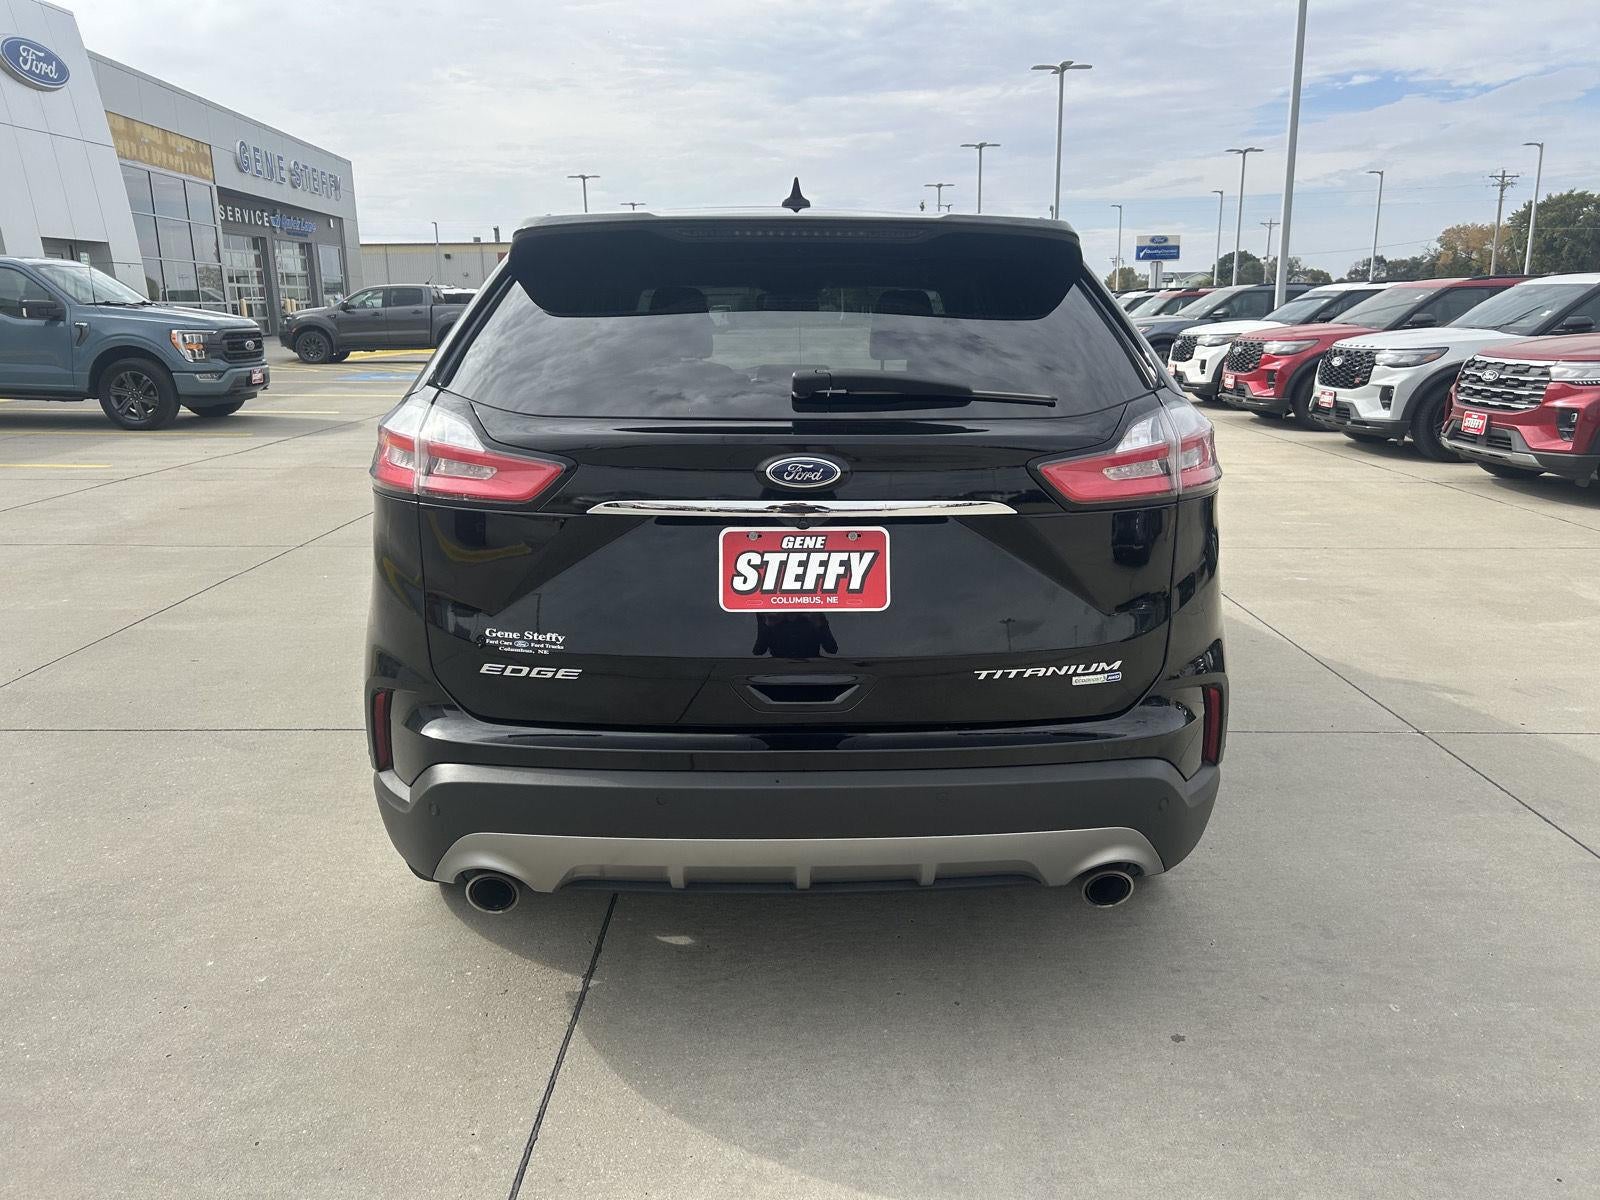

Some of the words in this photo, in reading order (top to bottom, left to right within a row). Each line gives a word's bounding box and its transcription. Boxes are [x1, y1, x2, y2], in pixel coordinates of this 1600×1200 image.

[19, 45, 59, 79] Ford
[236, 140, 287, 185] GENE
[289, 160, 342, 201] STEFFY
[219, 205, 270, 227] SERVICE
[783, 463, 823, 481] Ford
[781, 536, 827, 549] GENE
[732, 552, 875, 591] STEFFY
[770, 596, 824, 604] COLUMBUS,
[826, 596, 839, 604] NE
[485, 628, 521, 639] Gene
[523, 631, 566, 644] Steffy
[480, 663, 583, 680] EDGE
[974, 660, 1123, 680] TITANIUM
